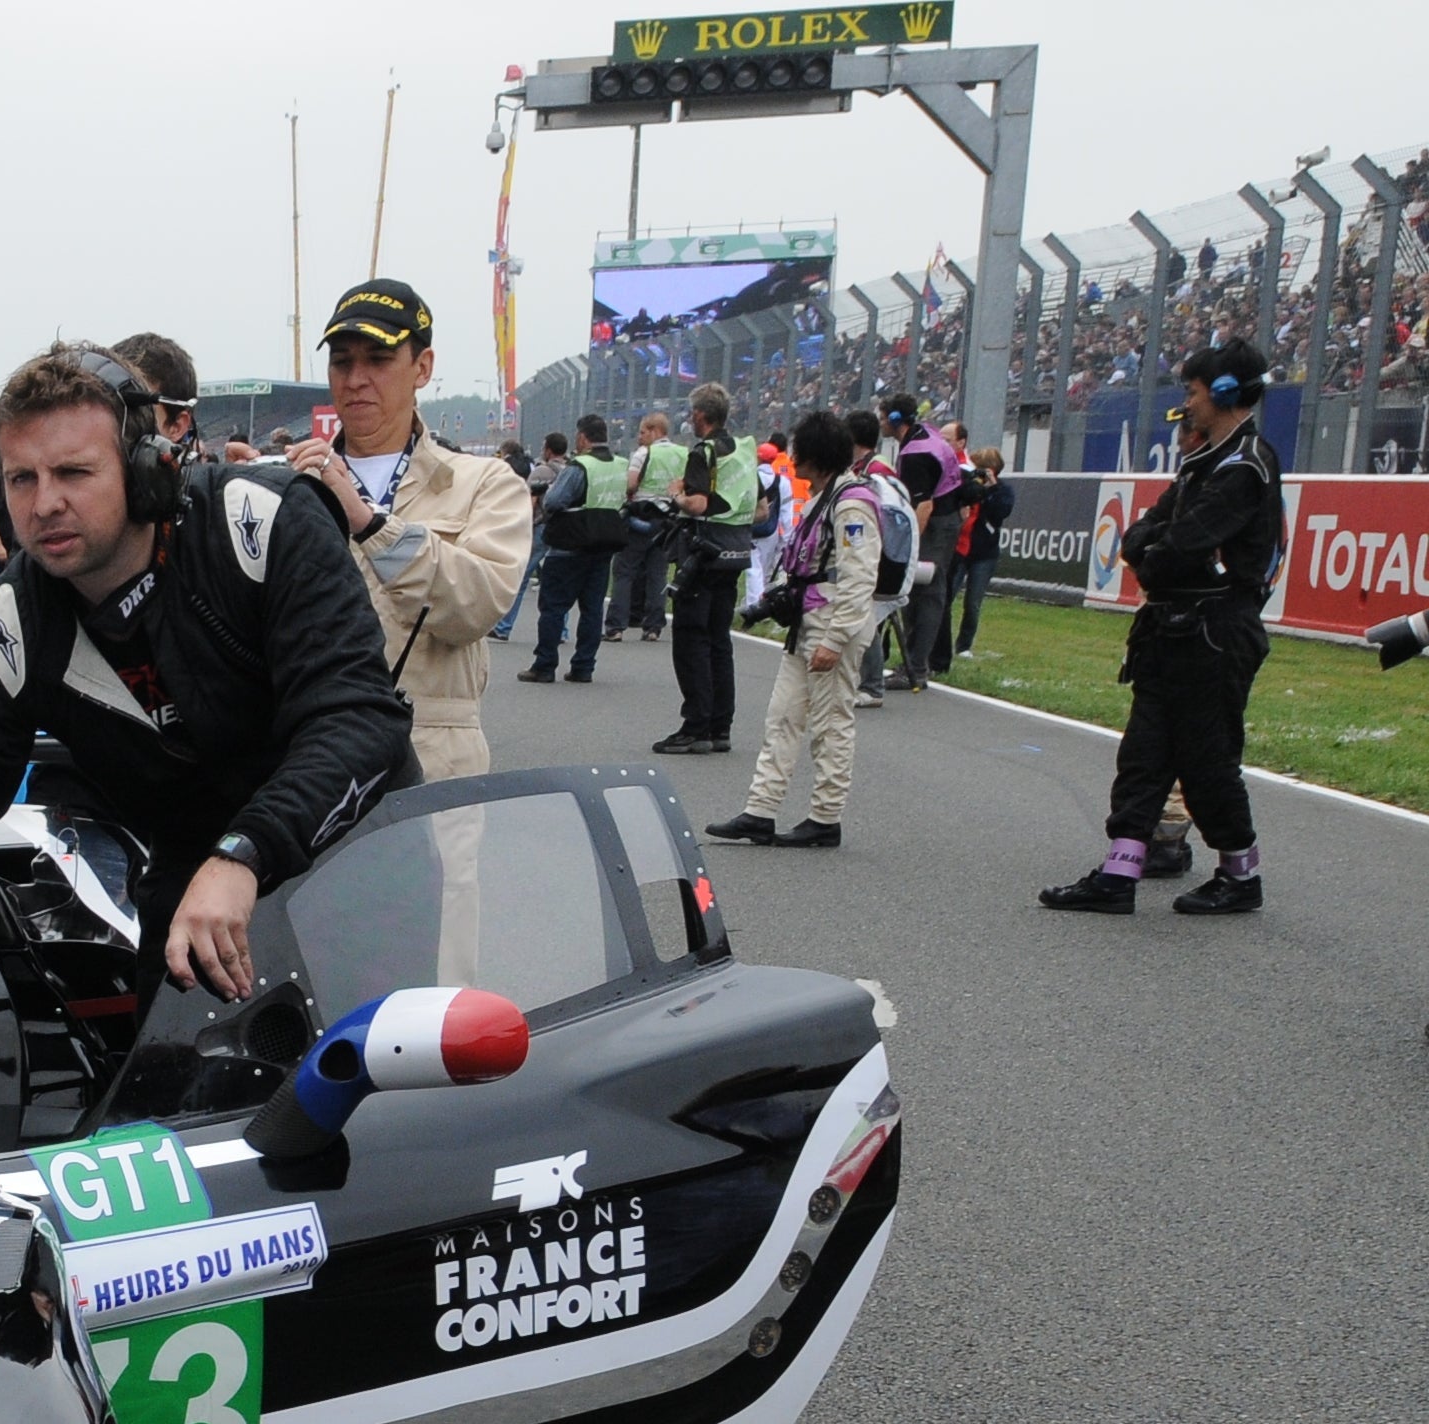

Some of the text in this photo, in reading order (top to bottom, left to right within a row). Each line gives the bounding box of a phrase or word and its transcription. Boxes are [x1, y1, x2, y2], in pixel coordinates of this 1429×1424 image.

[695, 8, 869, 53] ROLEX
[338, 292, 404, 314] DUNLOP
[998, 528, 1089, 564] PEUGEOT
[118, 572, 156, 619] DKR
[49, 1137, 191, 1222] GT1
[435, 1195, 644, 1252] MAISONS
[94, 1260, 189, 1312] HEURES
[197, 1248, 232, 1283] DU
[241, 1225, 315, 1271] MANS
[280, 1256, 318, 1276] 2010
[434, 1223, 646, 1306] FRANCE
[435, 1273, 646, 1352] CONFORT
